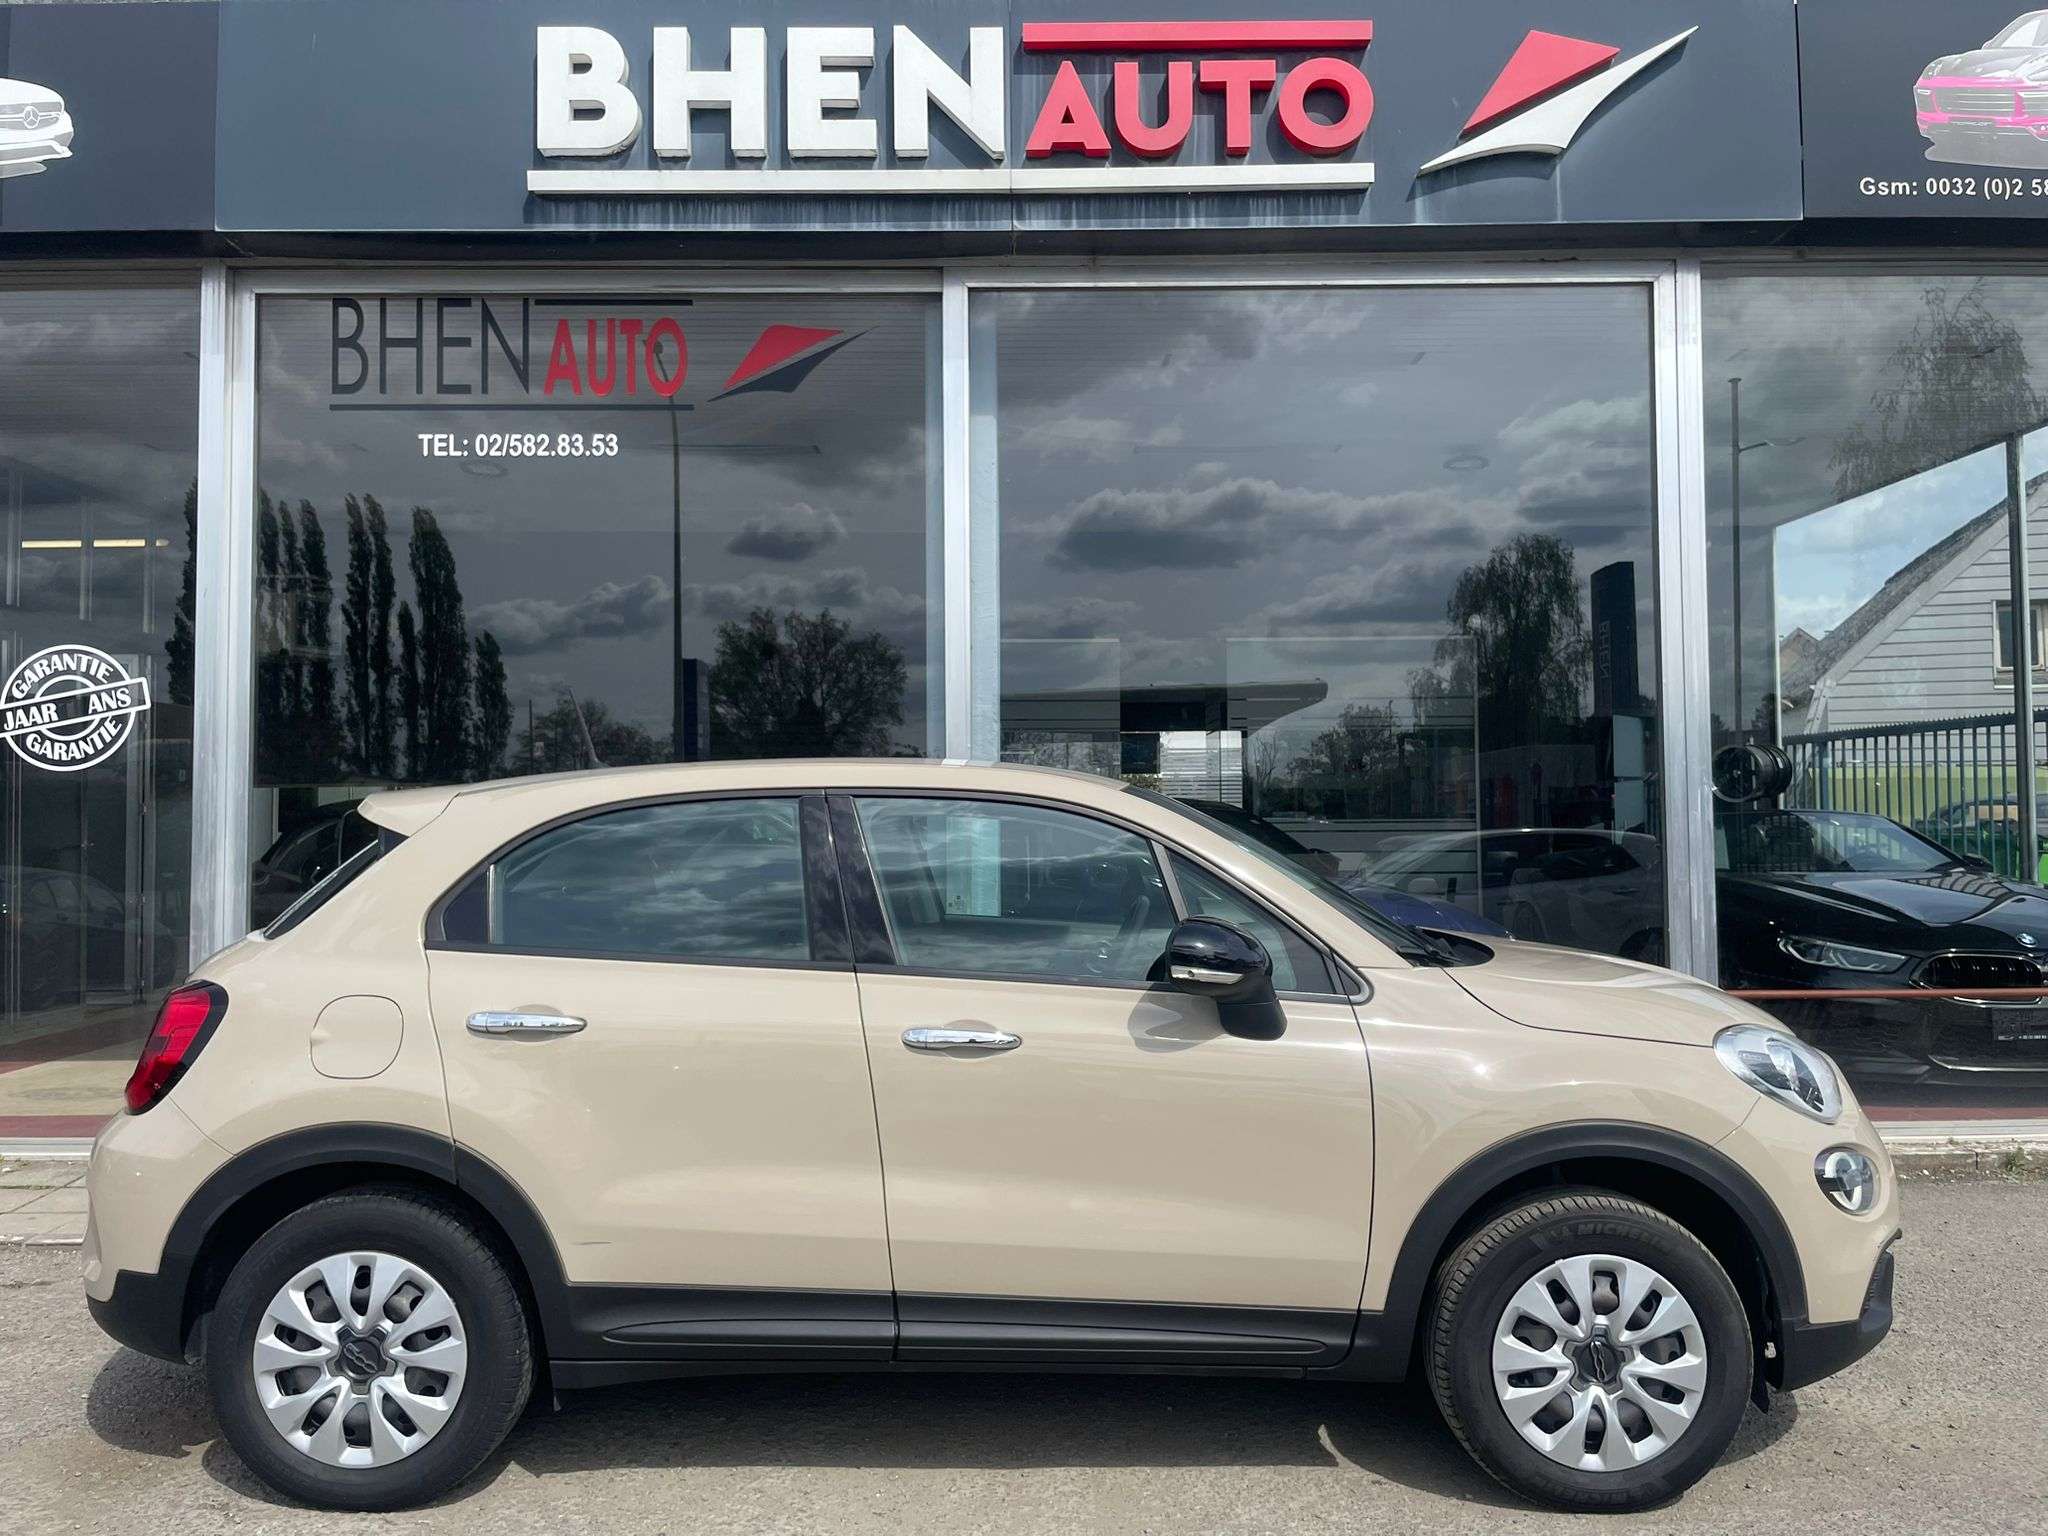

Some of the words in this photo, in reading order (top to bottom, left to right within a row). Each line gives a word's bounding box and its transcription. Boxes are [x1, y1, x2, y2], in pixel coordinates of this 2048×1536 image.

[537, 25, 1004, 159] BHEN
[1025, 57, 1375, 158] AUTO
[1859, 176, 1918, 196] Gsm:
[1925, 177, 1976, 196] 0032
[1983, 177, 2024, 200] (0)2
[331, 297, 530, 395] BHEN
[543, 316, 689, 397] AUTO
[418, 434, 469, 457] TEL:
[475, 433, 619, 457] 02/582.83.53
[11, 653, 114, 699] GARANTIE
[3, 702, 59, 731] JAAR
[88, 687, 132, 715] ANS
[25, 715, 123, 761] GARANTIE
